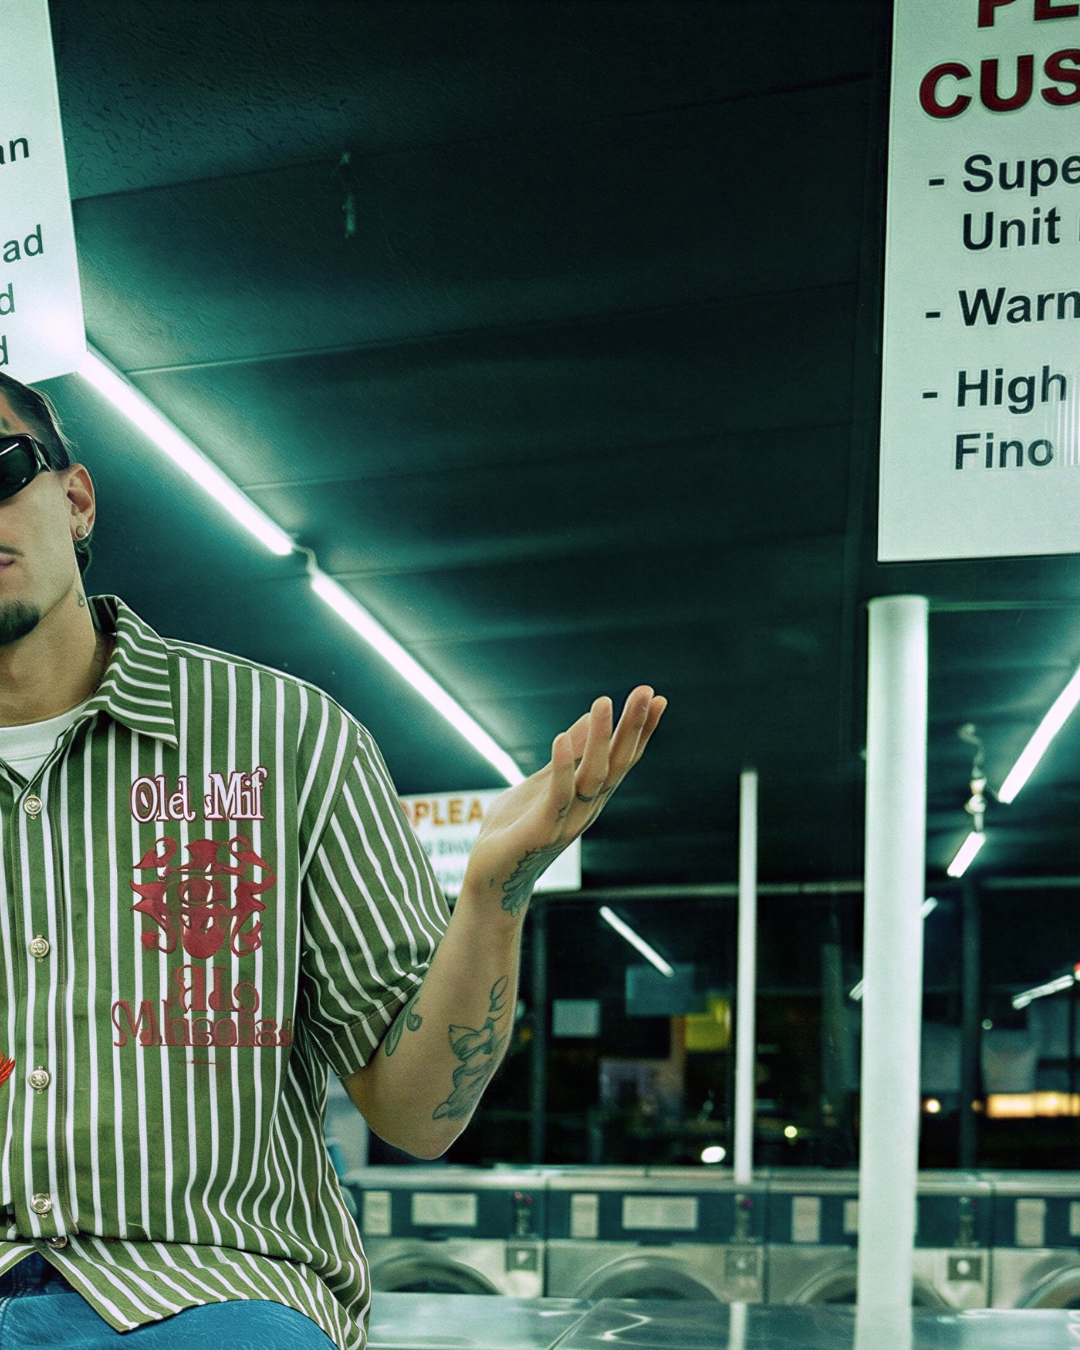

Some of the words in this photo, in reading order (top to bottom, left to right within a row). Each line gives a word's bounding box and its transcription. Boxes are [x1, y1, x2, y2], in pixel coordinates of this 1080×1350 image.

[919, 48, 1080, 119] CUS
[963, 154, 1080, 197] Supe
[963, 207, 1061, 250] Unit
[957, 365, 1067, 414] High
[130, 774, 196, 823] Old
